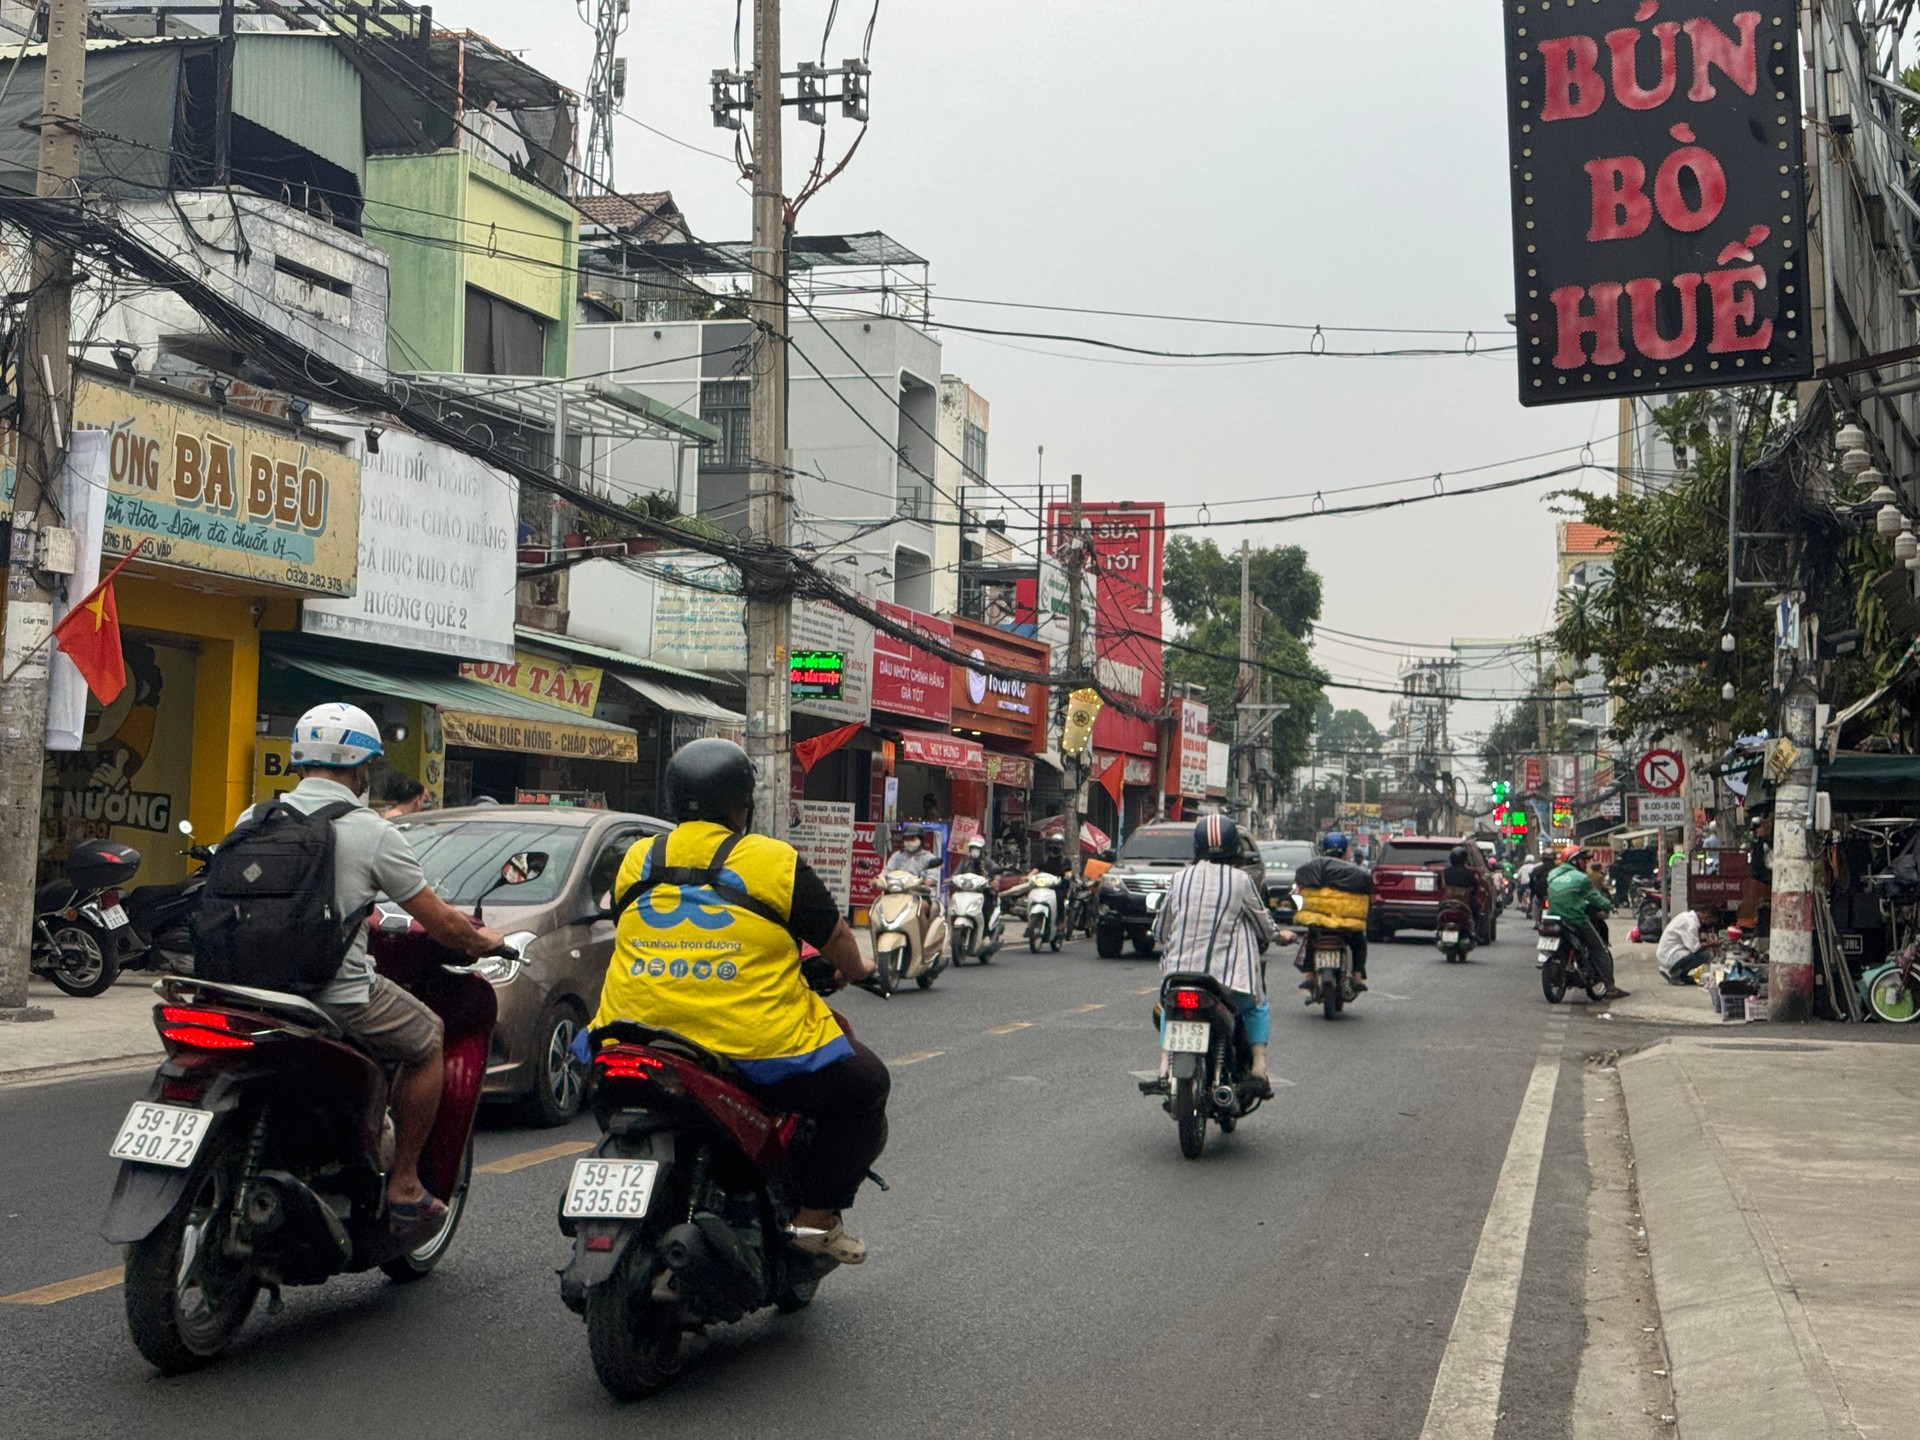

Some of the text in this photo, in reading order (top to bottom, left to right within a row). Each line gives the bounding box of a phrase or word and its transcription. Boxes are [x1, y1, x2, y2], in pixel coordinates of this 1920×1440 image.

[1537, 0, 1761, 121] BÚN
[1584, 122, 1727, 242] BÒ
[1550, 224, 1773, 369] HUẾ
[172, 431, 234, 510] BÀ
[247, 444, 325, 531] BÉO
[128, 500, 159, 530] Hòa
[285, 568, 309, 585] 0328
[309, 573, 327, 589] 282
[529, 663, 594, 709] TẤM
[500, 722, 521, 746] ĐÚC
[523, 726, 552, 751] NÓNG
[650, 938, 677, 949] nhau
[680, 938, 703, 951] trọn
[704, 937, 742, 951] đường
[137, 1108, 198, 1136] 59-V3
[117, 1132, 193, 1162] 290.72
[584, 1165, 644, 1188] 59-T2
[572, 1190, 644, 1213] 535.65
